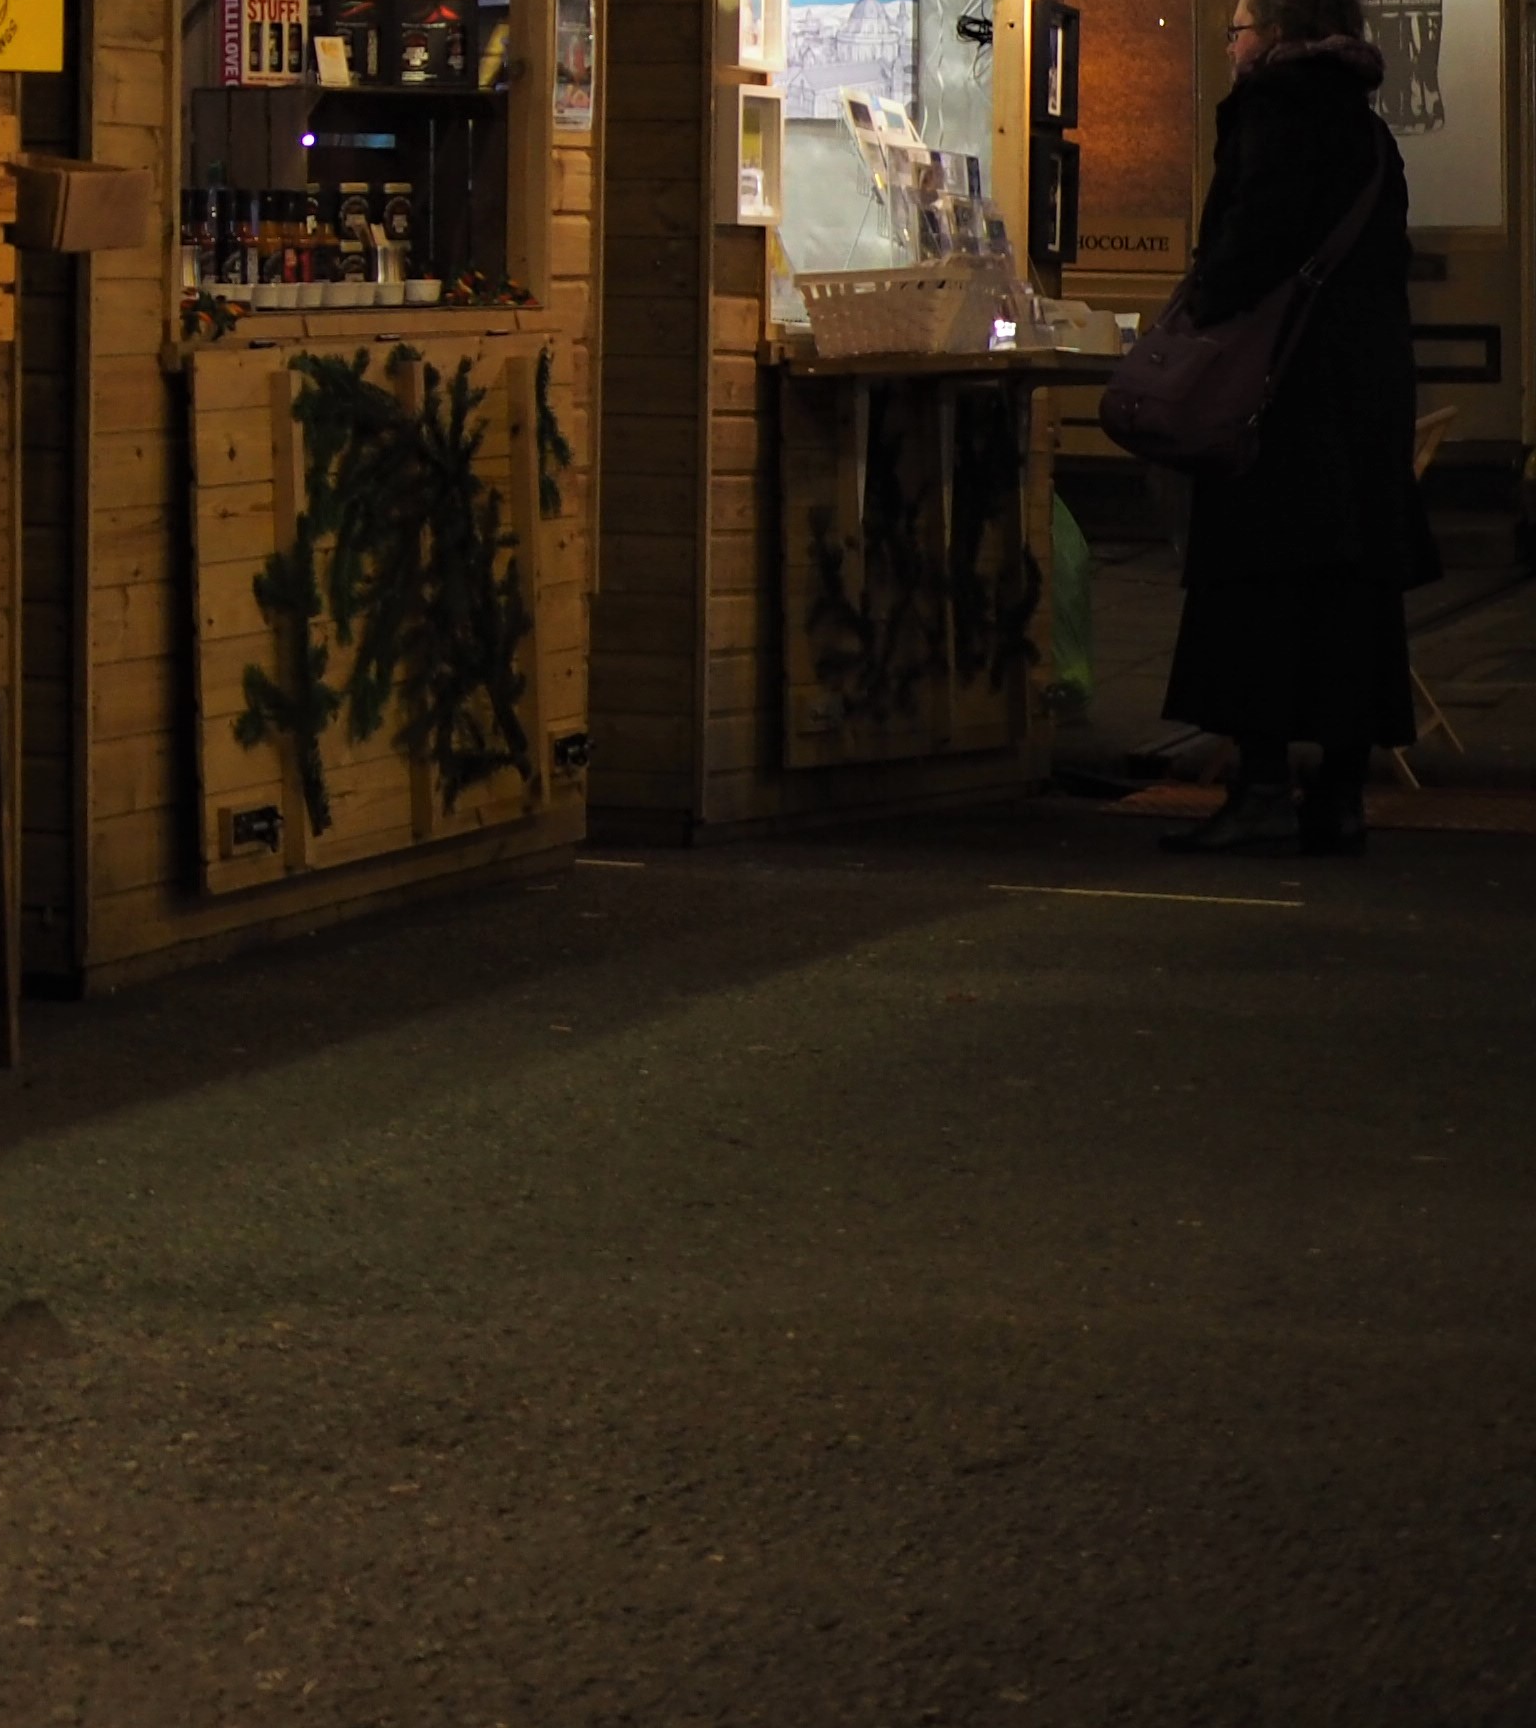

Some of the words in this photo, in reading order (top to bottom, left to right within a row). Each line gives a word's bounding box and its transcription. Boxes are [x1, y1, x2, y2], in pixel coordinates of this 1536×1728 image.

[247, 0, 300, 23] STUFF!
[225, 32, 239, 77] LOVE
[1077, 234, 1169, 252] HOCOLATE
